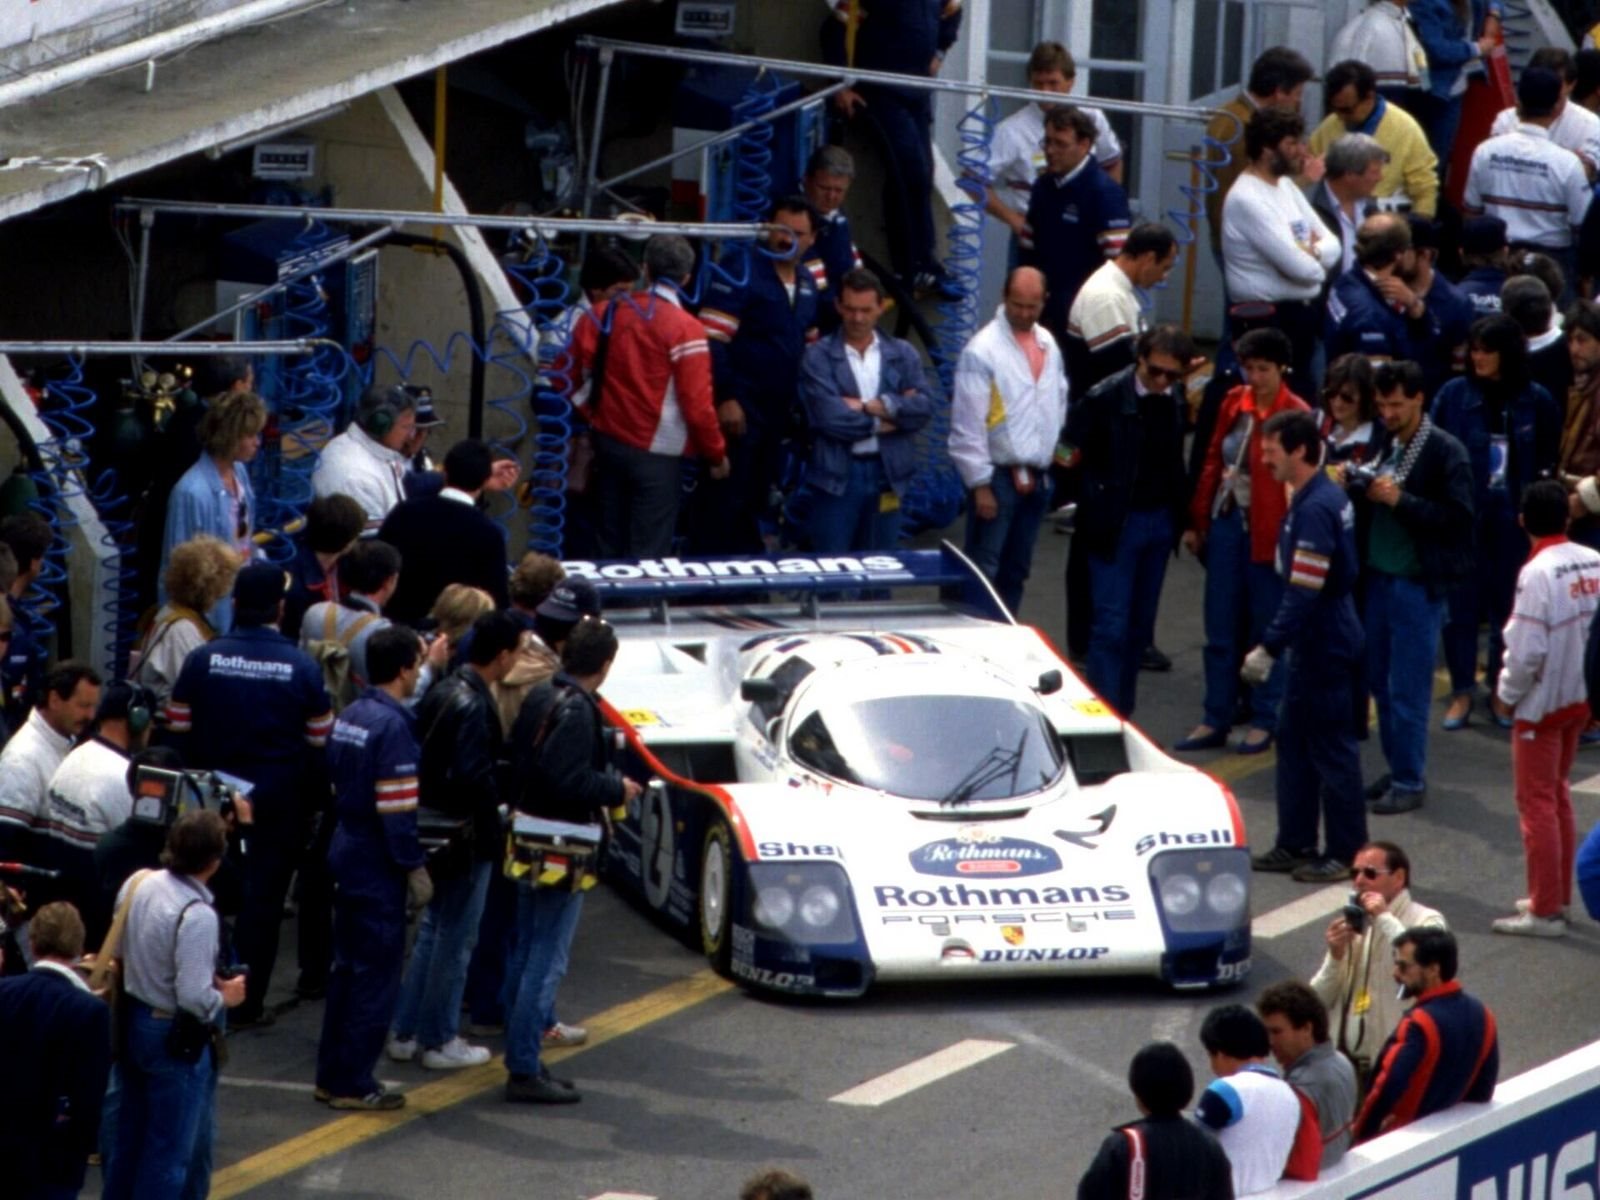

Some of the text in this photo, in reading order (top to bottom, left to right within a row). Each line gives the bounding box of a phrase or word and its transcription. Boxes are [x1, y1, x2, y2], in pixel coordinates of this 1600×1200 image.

[1469, 293, 1501, 308] Roth
[559, 555, 904, 580] Rothmans
[209, 653, 293, 674] Rothmans
[758, 842, 843, 858] She
[1135, 829, 1232, 856] Shell
[873, 884, 1130, 908] Rothmans
[882, 910, 1136, 924] PORSCHE
[980, 947, 1109, 962] DUNLOP
